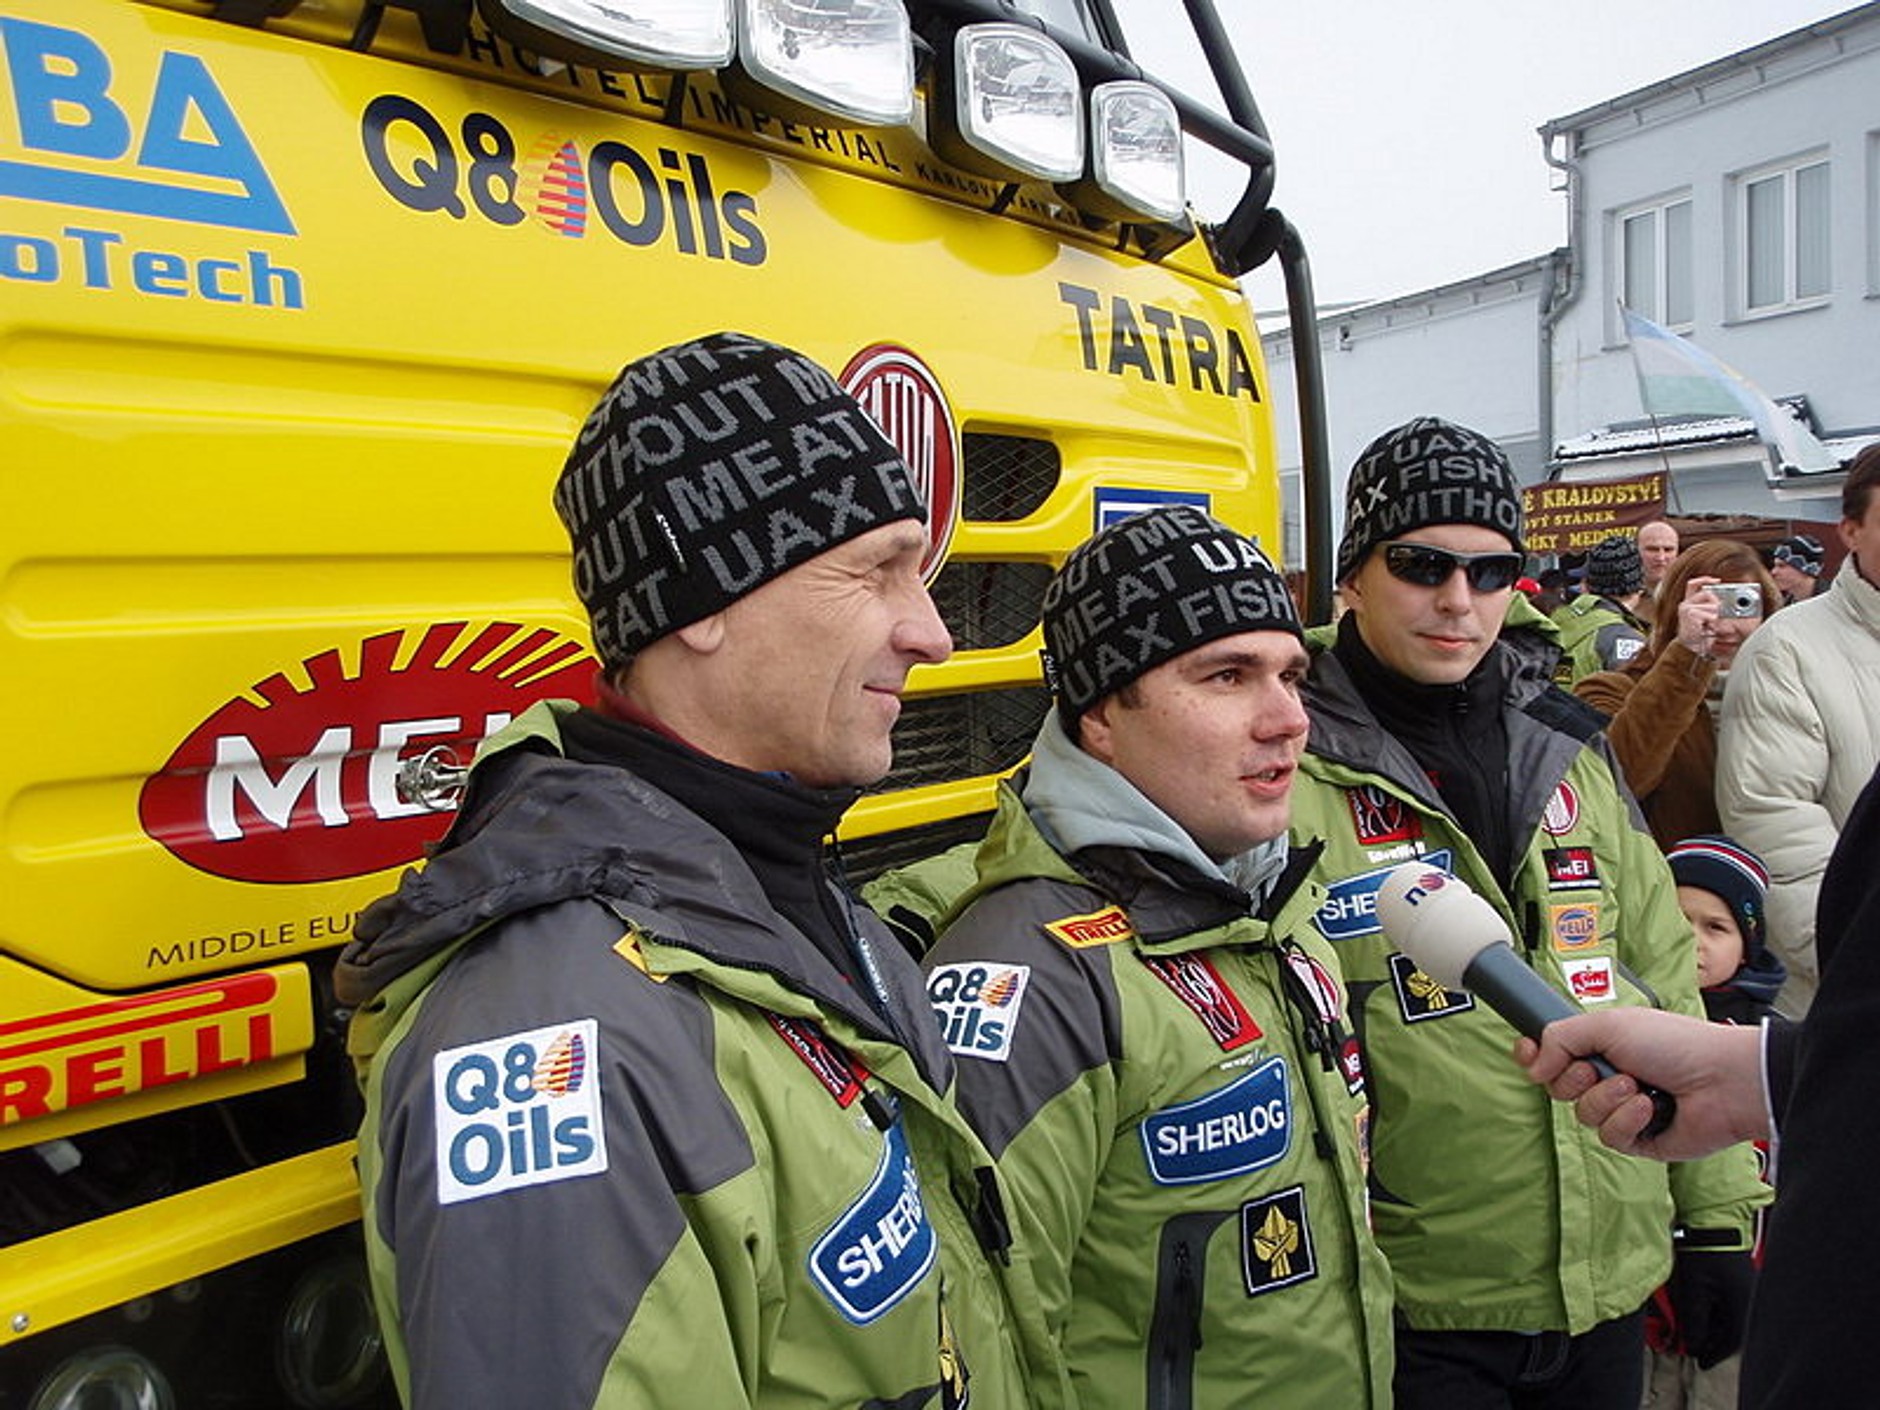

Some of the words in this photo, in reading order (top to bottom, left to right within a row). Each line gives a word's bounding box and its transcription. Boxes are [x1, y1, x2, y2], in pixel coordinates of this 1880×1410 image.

[362, 94, 526, 226] Q8
[588, 140, 767, 267] Oils
[1057, 281, 1261, 403] TATRA
[665, 410, 870, 533] MEAT
[1399, 455, 1504, 491] FISH
[701, 476, 875, 595] UAX
[1052, 555, 1178, 662] MEAT
[1063, 611, 1175, 703] UAX
[1177, 576, 1294, 637] FISH
[147, 923, 296, 969] MIDDLE
[309, 911, 361, 938] EU
[1322, 890, 1379, 922] SHE
[929, 967, 989, 1004] Q8
[443, 1042, 538, 1115] Q8
[449, 1104, 596, 1186] Oils
[1157, 1098, 1285, 1157] SHERLOG
